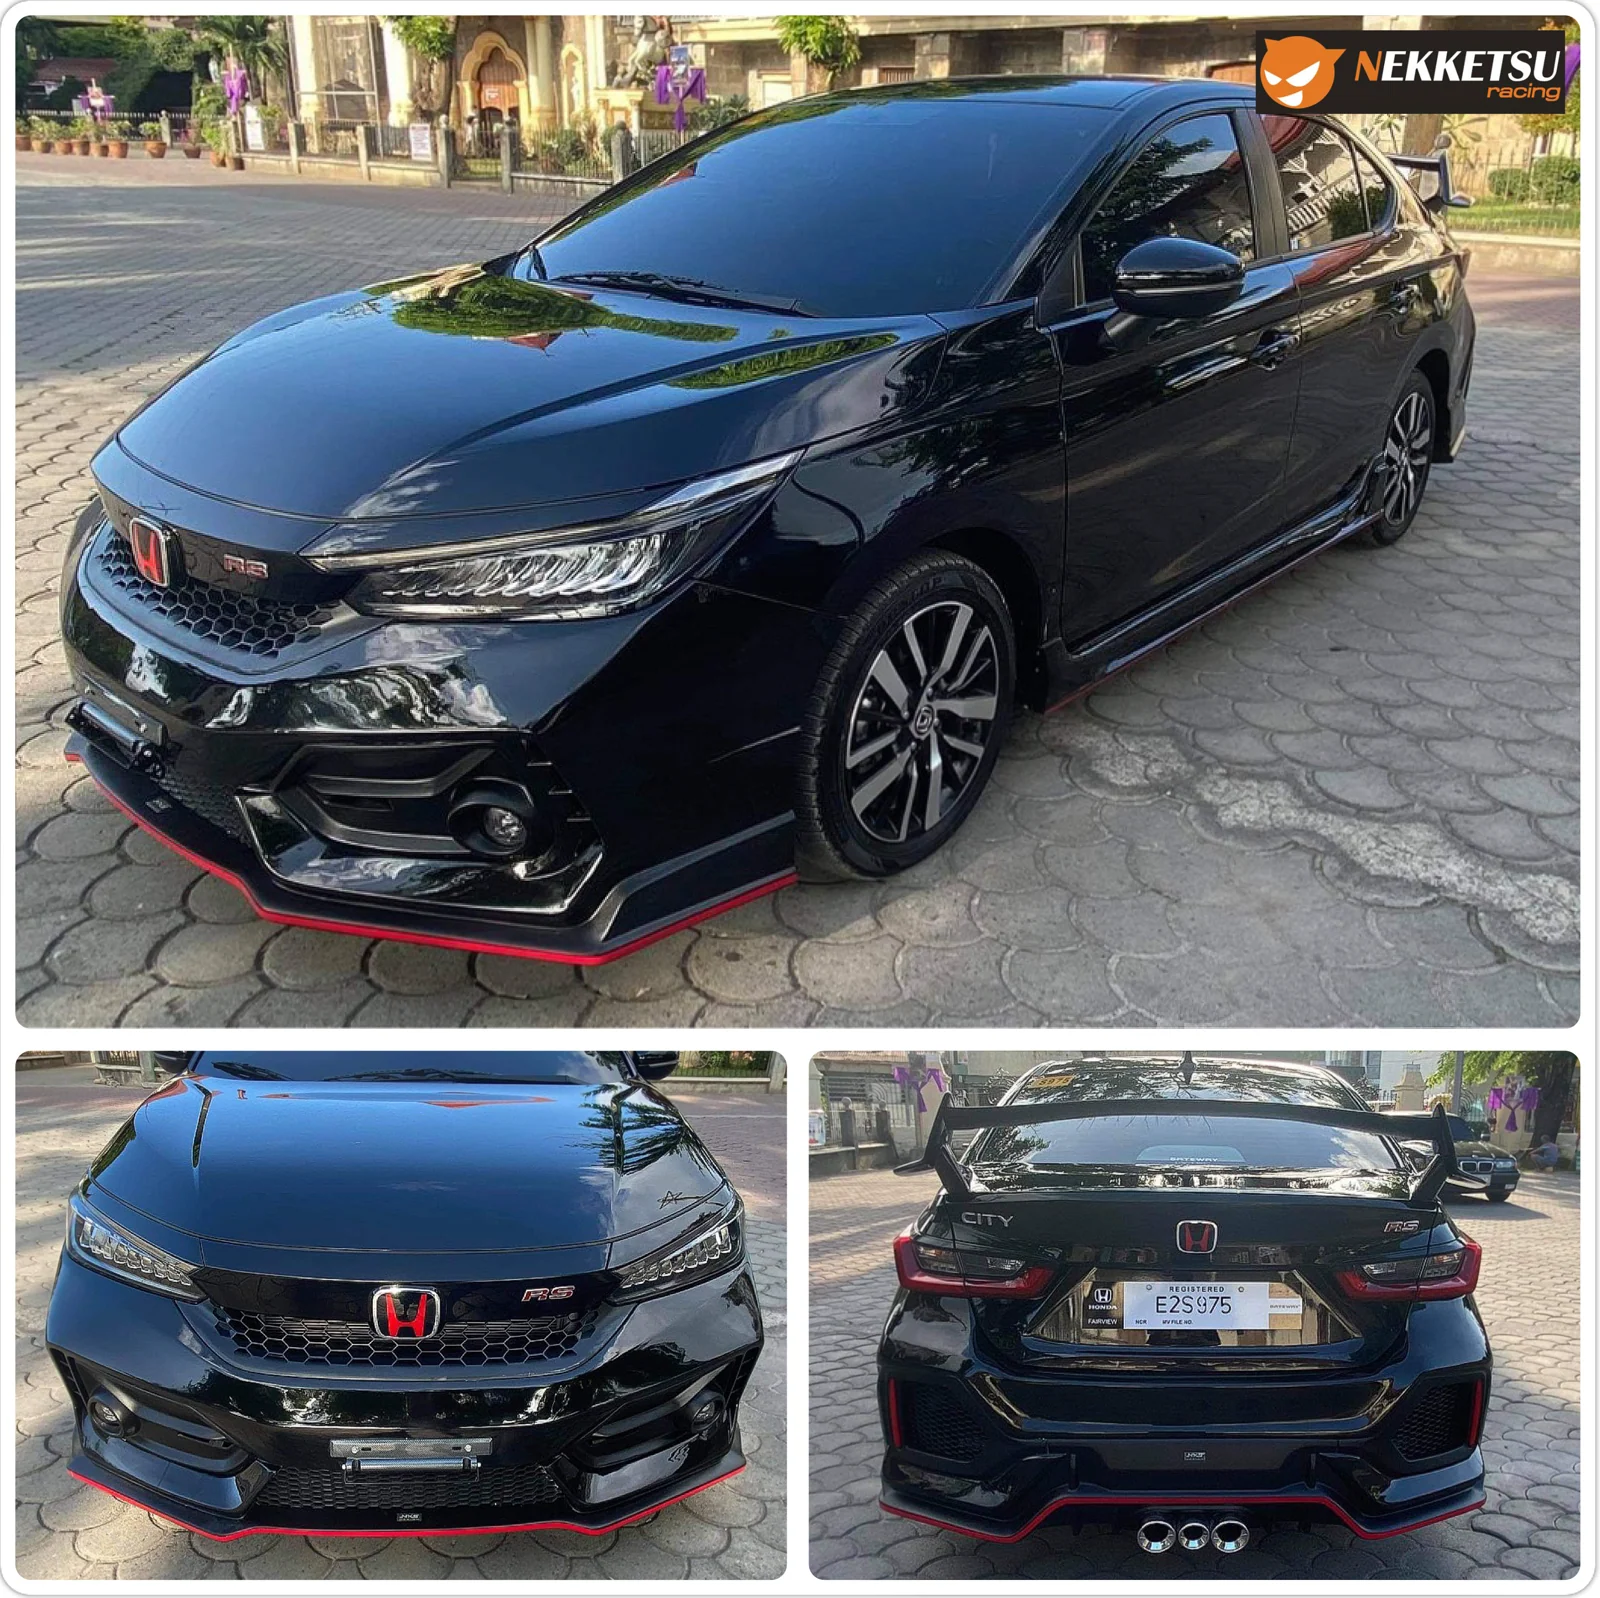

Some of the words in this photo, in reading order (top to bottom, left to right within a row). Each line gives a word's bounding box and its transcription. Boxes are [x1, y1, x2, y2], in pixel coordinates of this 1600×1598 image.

[961, 1211, 1014, 1227] CITY
[1383, 1220, 1420, 1234] RS
[521, 1285, 576, 1302] RS
[1156, 1295, 1232, 1315] E2S975
